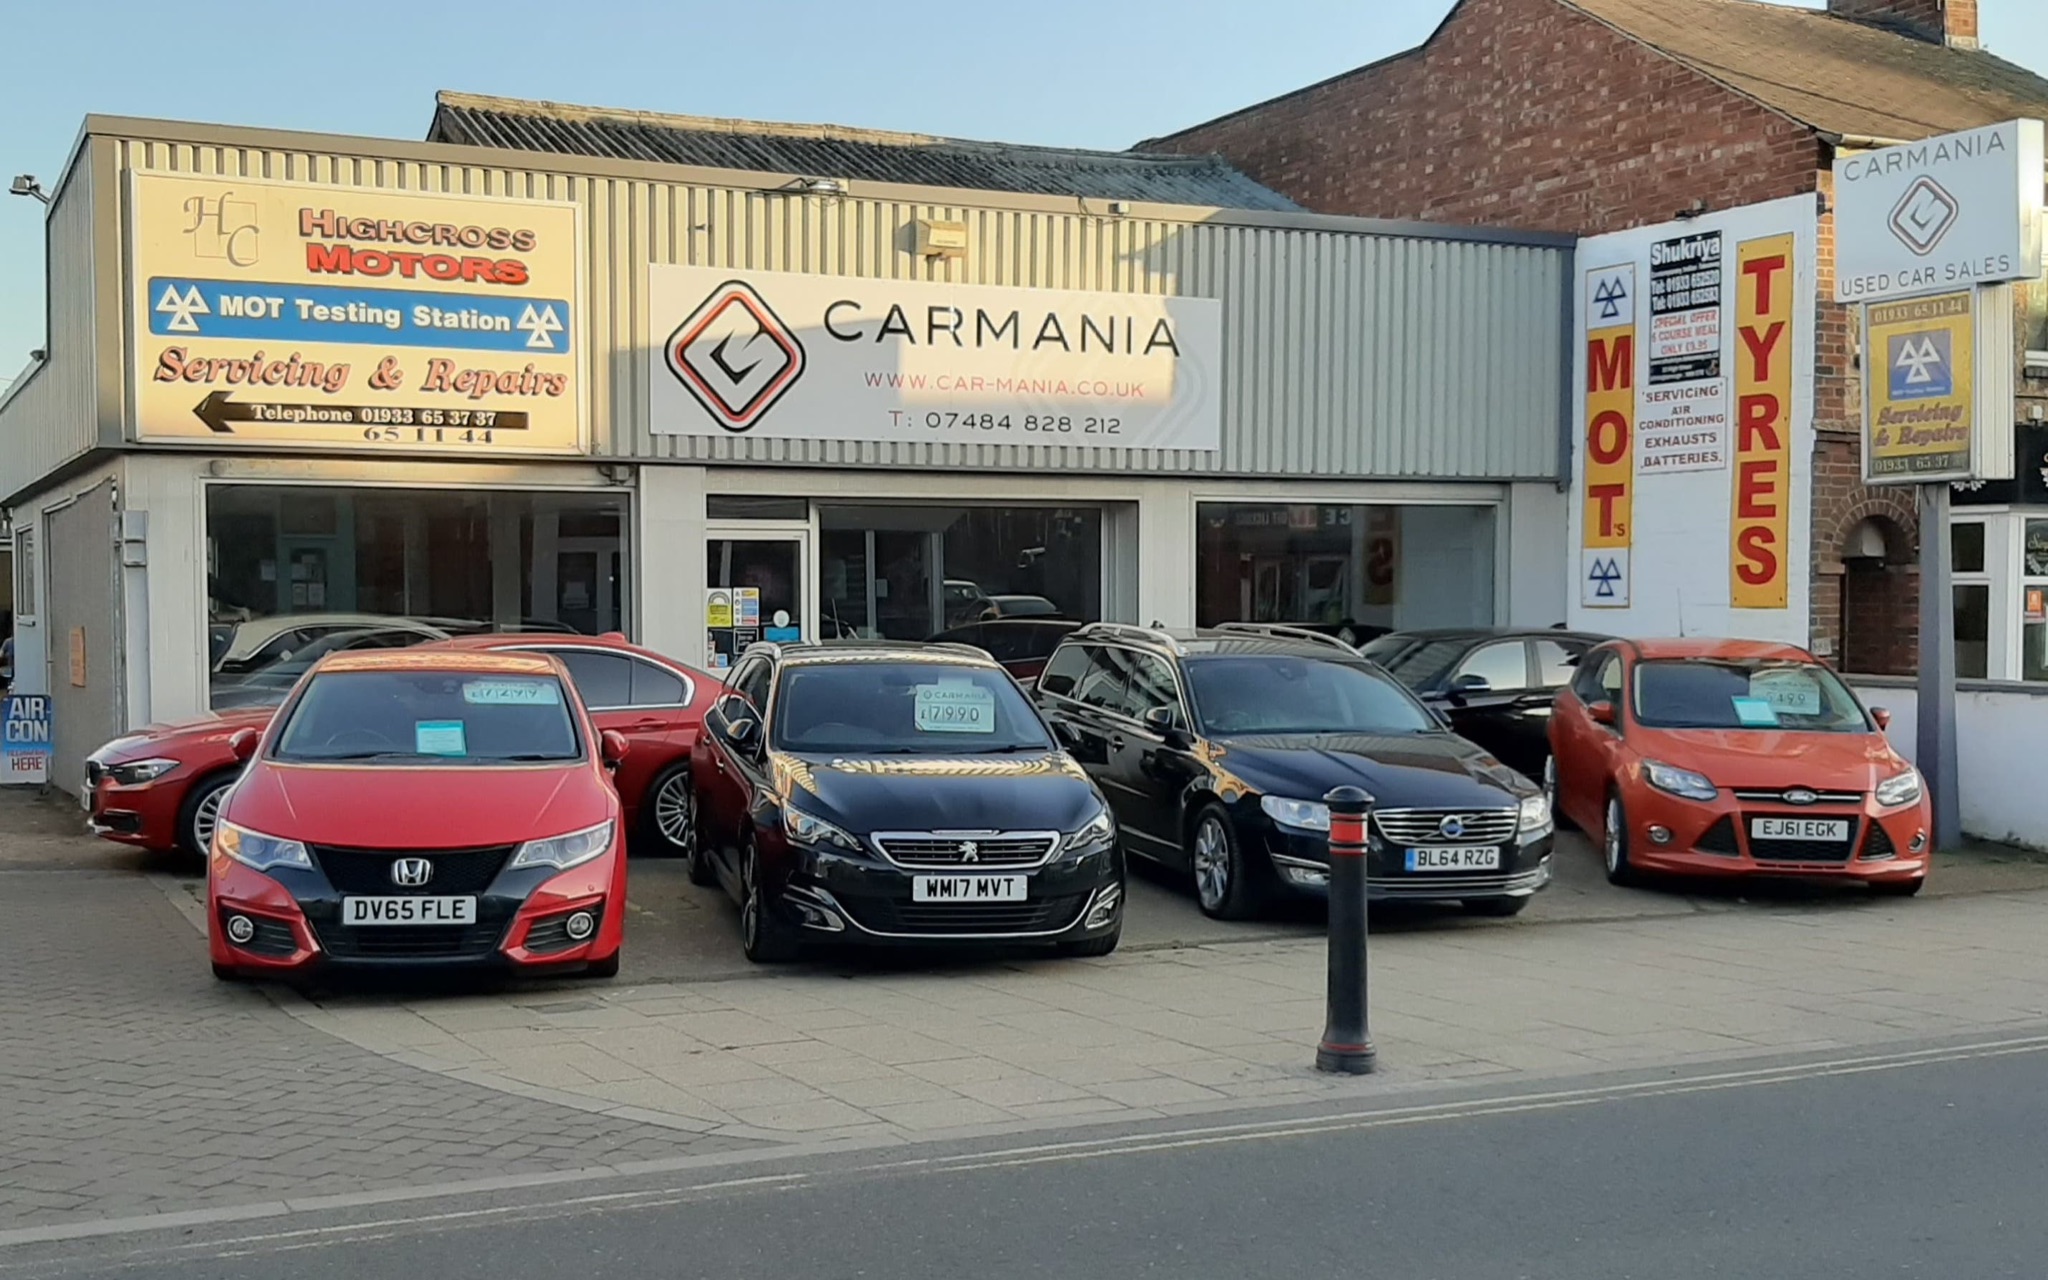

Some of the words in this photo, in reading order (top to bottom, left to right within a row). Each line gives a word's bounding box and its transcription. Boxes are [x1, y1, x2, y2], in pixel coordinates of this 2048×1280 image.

[1844, 131, 2005, 182] CARMANIA
[299, 208, 537, 252] HIGHCROSS
[1651, 235, 1720, 265] Shukriya
[306, 242, 530, 285] MOTORS
[1841, 273, 1890, 297] USED
[1899, 267, 1936, 288] CAR
[1945, 255, 2010, 281] SALES
[220, 295, 285, 319] MOT
[295, 299, 402, 329] Testing
[413, 305, 511, 331] Station
[1691, 309, 1717, 323] OFFER
[1874, 306, 1908, 323] 01933
[1914, 304, 1928, 317] 65
[823, 299, 1181, 358] CARMANIA
[1659, 327, 1693, 341] COURSE
[153, 346, 352, 393] Servicing
[368, 355, 403, 390] &
[420, 358, 568, 399] Repairs
[865, 371, 1145, 398] WWW.CAR-MANIA.CO.UK
[1646, 385, 1719, 403] SERVICING
[250, 404, 353, 423] Telephone
[361, 408, 414, 424] 01933
[422, 410, 444, 425] 65
[450, 411, 470, 426] 37
[475, 412, 497, 427] 37
[1671, 405, 1691, 416] AIR
[1736, 254, 1786, 585] TYRES
[1877, 402, 1964, 426] Servicing
[887, 411, 912, 428] T:
[925, 411, 1012, 431] 07484
[1024, 413, 1072, 433] 828
[1084, 416, 1122, 434] 212
[1639, 414, 1724, 430] CONDITIONING
[363, 427, 399, 443] 65
[416, 428, 443, 443] 11
[459, 430, 492, 444] 44
[1645, 432, 1717, 448] EXHAUSTS
[5, 720, 49, 742] CON
[12, 757, 42, 771] HERE
[1762, 821, 1800, 837] EJ61
[1806, 820, 1837, 837] EGK
[1417, 850, 1460, 867] BL64
[1464, 849, 1495, 865] RZG
[926, 878, 970, 898] WM17
[977, 878, 1015, 897] MVT
[354, 899, 414, 920] DV65
[421, 899, 466, 920] FLE
